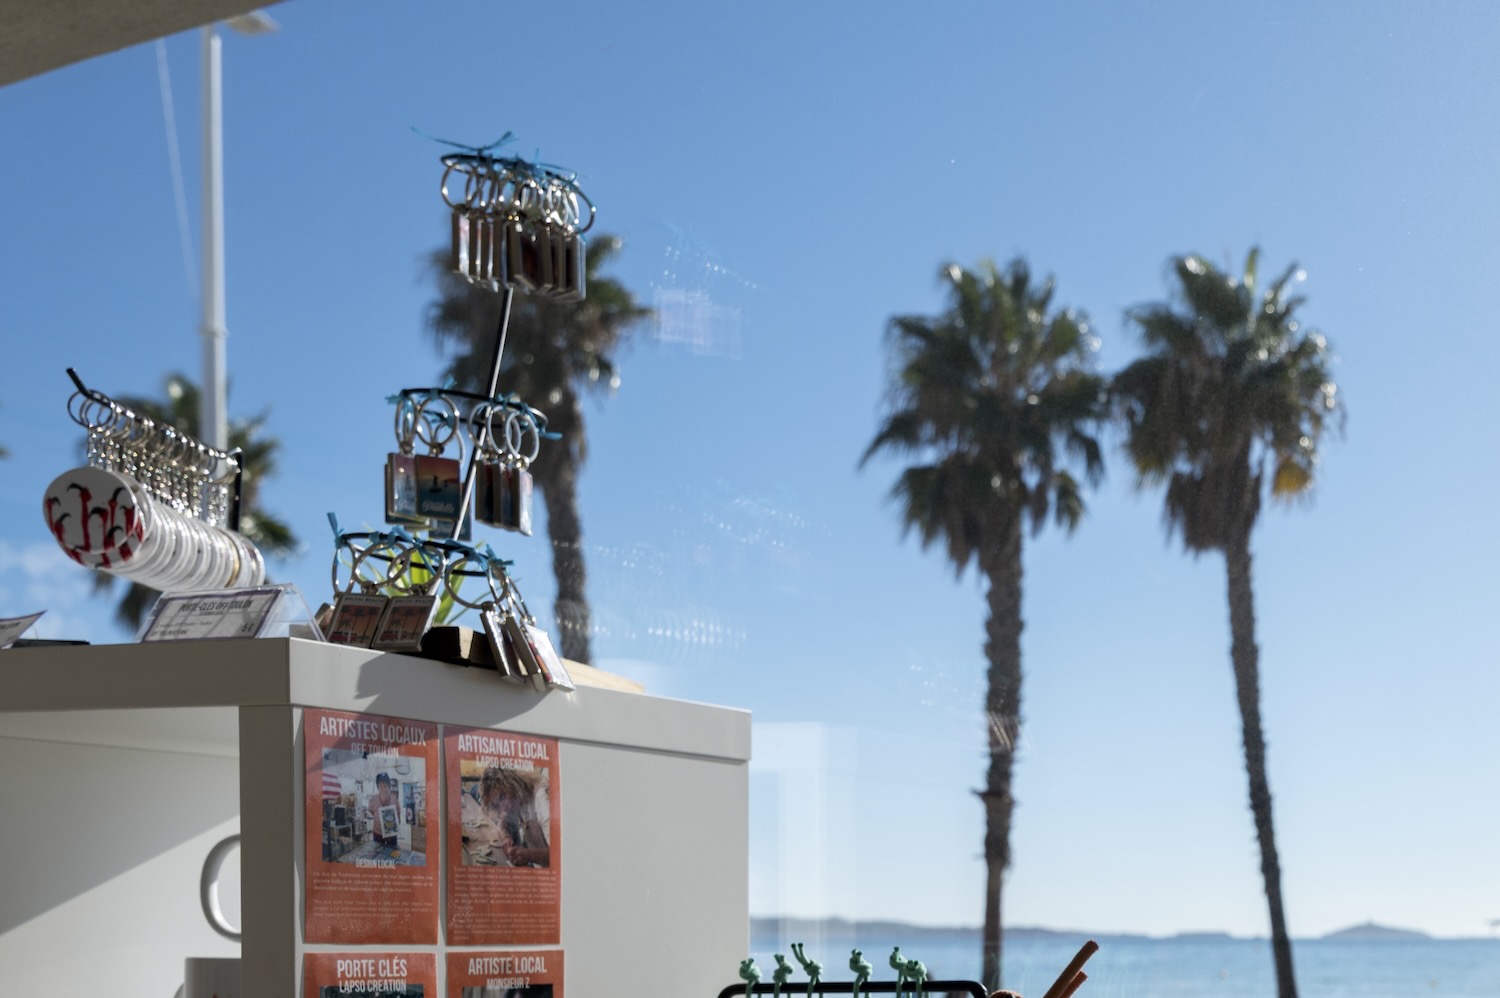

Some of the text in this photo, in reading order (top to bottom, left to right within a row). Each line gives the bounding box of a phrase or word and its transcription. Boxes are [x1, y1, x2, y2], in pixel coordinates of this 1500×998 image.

[320, 716, 427, 747] ARTISTES LOCAUX
[457, 734, 550, 761] ARTISANAT LOCAL
[476, 754, 534, 772] LAPSO CREATION
[337, 956, 408, 978] PORTE CLÉS
[468, 956, 548, 976] ARTISTE LOCAL
[339, 978, 407, 993] LAPSO CREATION
[486, 976, 530, 991] MONSIEUR Z
